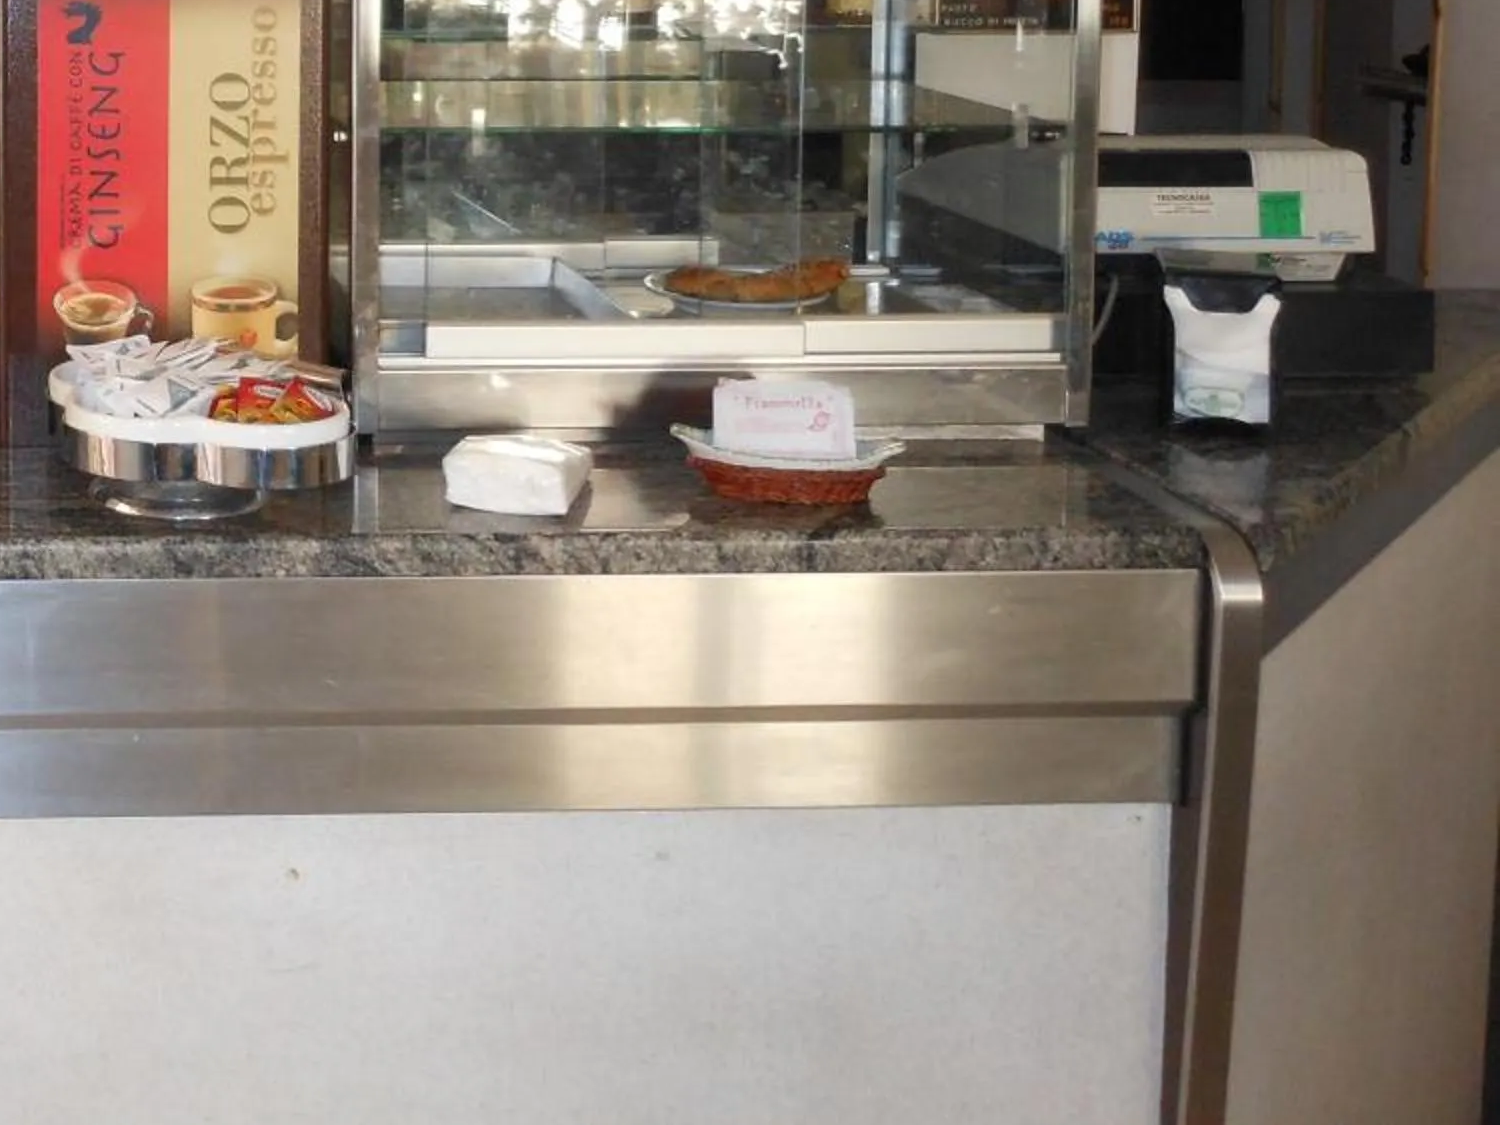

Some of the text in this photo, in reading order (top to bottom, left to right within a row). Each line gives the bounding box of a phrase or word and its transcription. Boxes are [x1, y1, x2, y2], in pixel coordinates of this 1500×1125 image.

[68, 50, 84, 89] CON
[249, 5, 290, 217] espresso
[69, 156, 83, 176] DI
[87, 50, 126, 250] GINSENG
[208, 72, 251, 235] ORZO
[68, 182, 83, 249] CREMA
